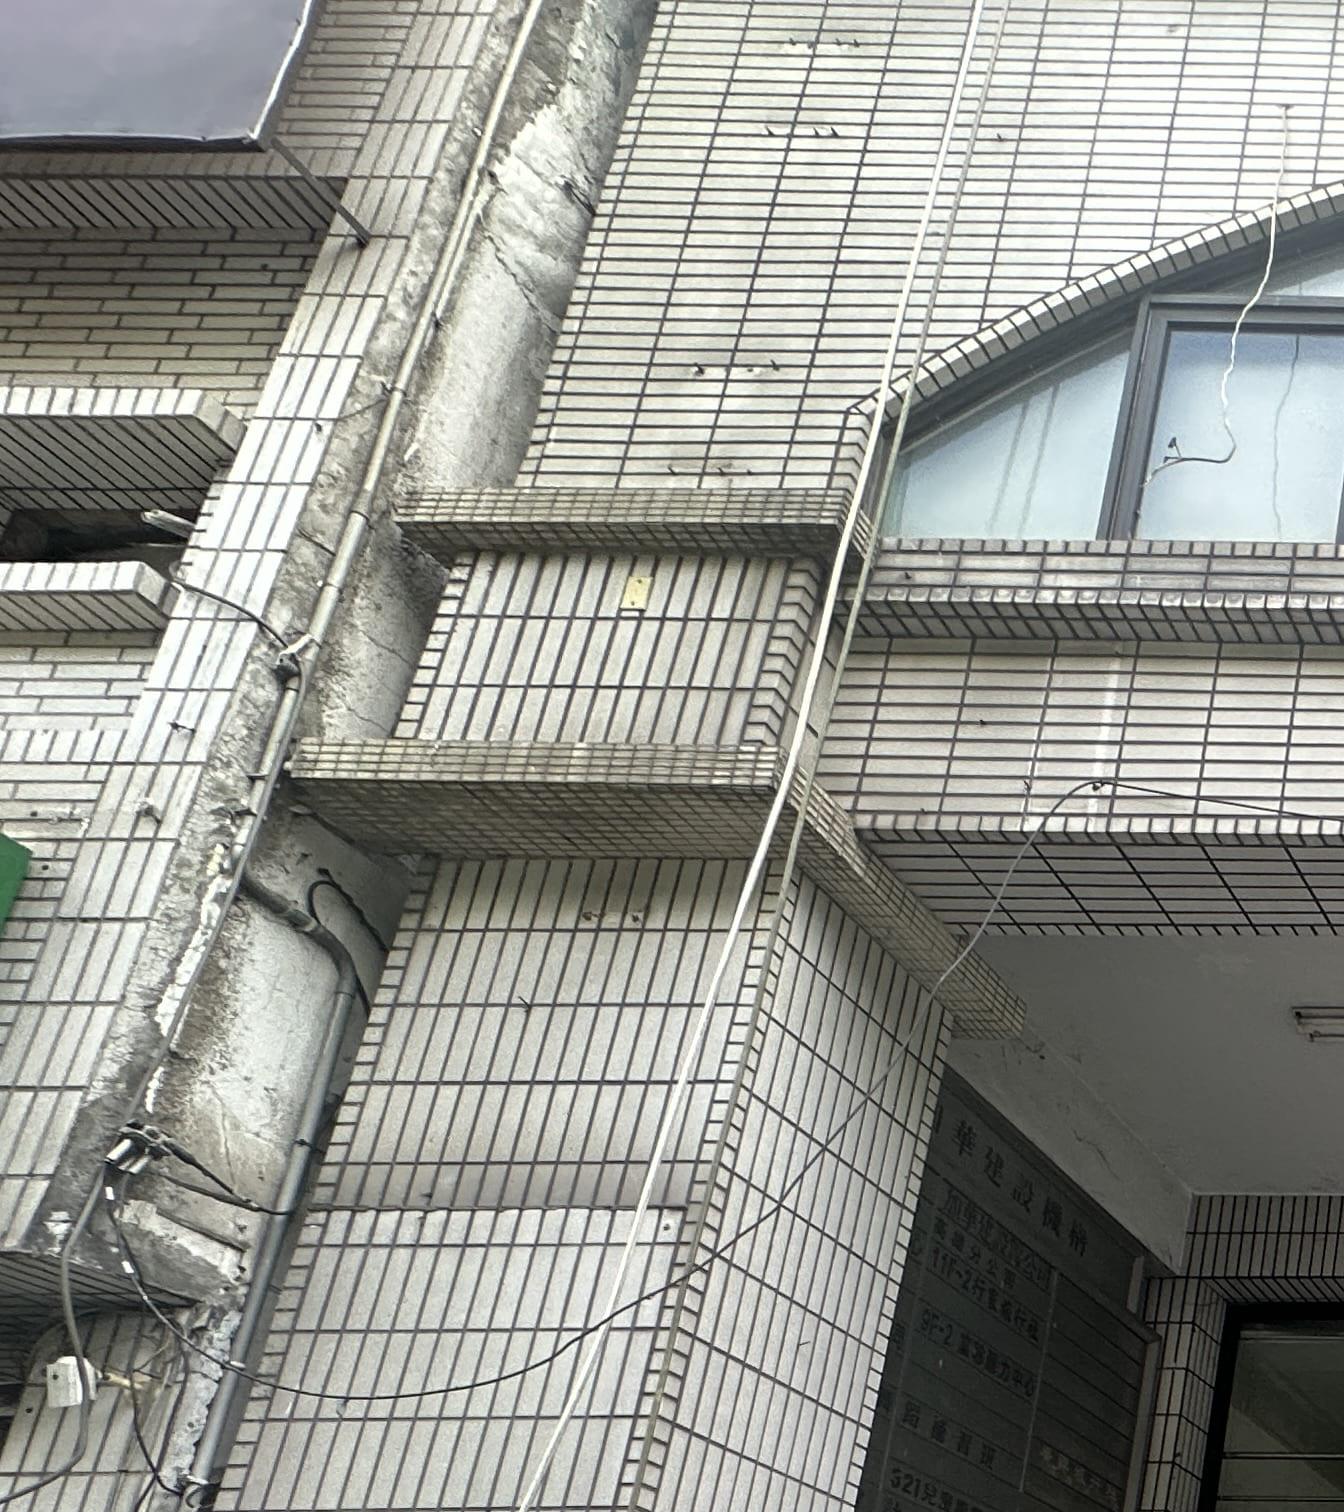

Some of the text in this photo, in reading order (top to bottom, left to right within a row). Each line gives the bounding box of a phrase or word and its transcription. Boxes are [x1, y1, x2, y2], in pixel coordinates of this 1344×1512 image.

[935, 1104, 1090, 1258] 華建設機構
